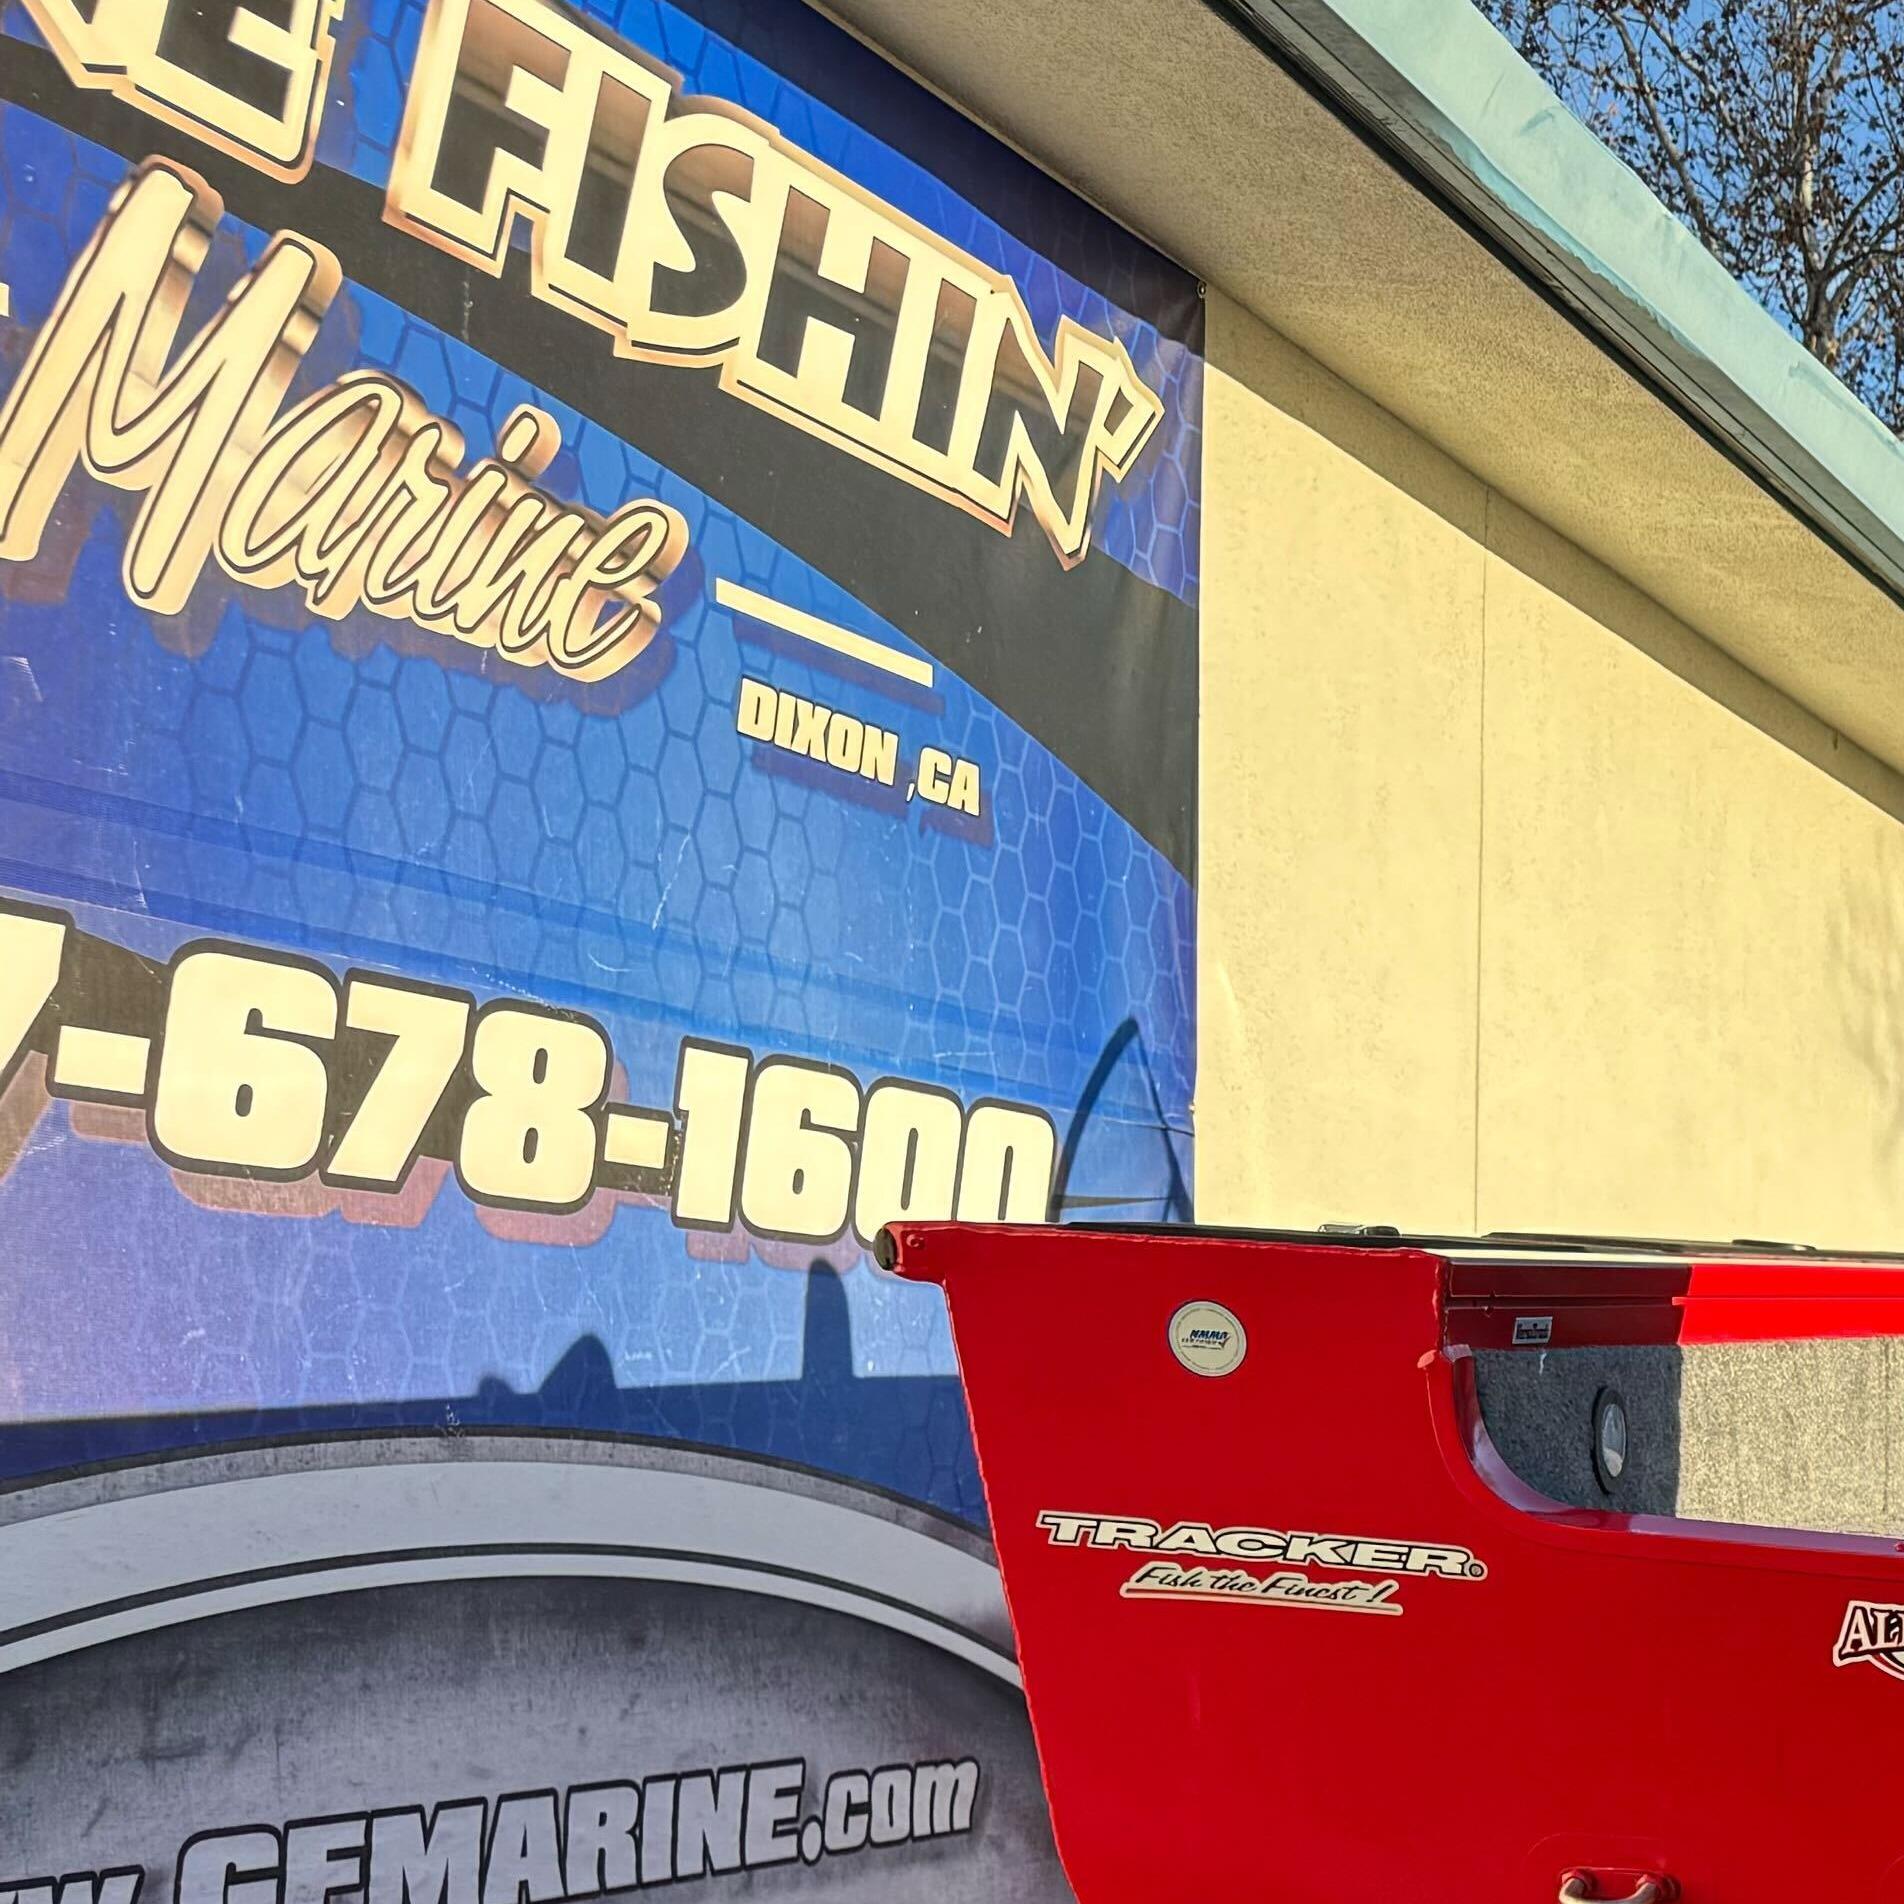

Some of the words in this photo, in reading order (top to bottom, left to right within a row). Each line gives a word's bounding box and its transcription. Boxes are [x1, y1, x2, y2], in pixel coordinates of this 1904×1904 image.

[402, 0, 1160, 562] FISHIN'
[0, 160, 684, 678] Marine
[737, 676, 899, 787] DIXON
[1040, 1513, 1473, 1577] TRACKER
[1135, 1566, 1203, 1588] Fish
[1210, 1573, 1255, 1592] the
